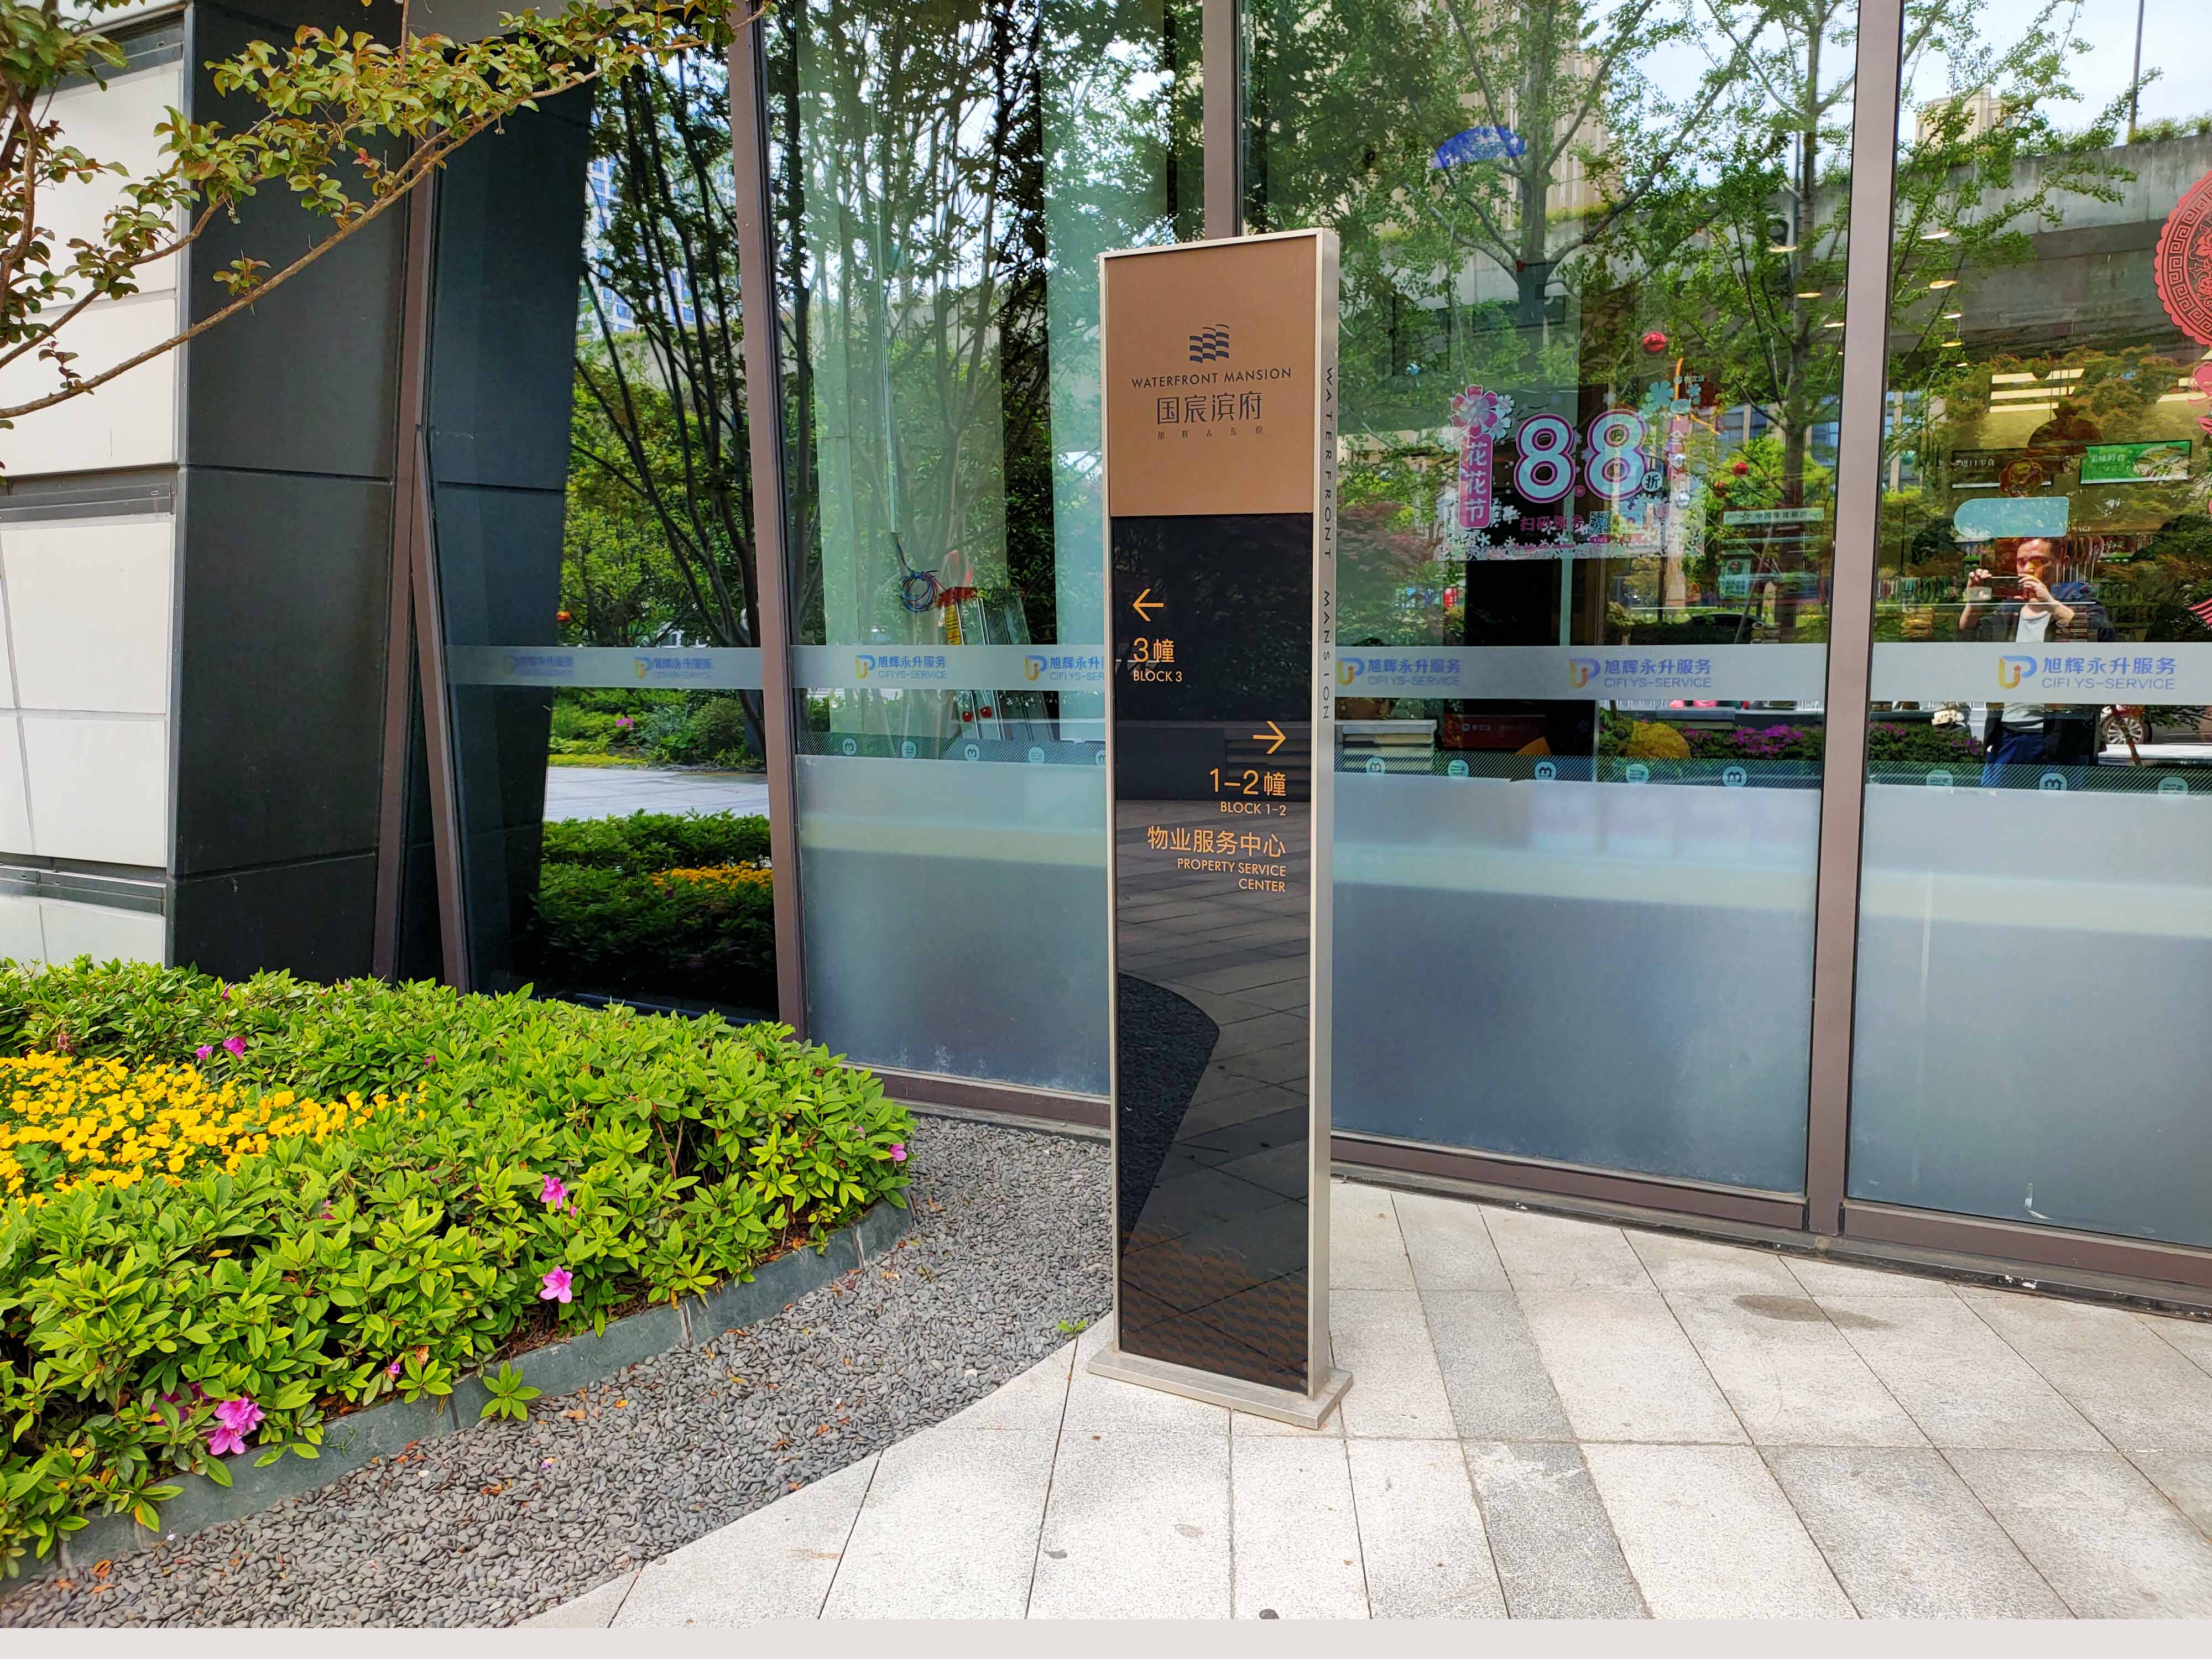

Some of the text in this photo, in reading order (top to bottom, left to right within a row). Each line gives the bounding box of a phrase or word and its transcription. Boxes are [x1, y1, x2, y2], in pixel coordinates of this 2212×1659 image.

[1131, 367, 1291, 388] WATERFRONT MANSION
[1157, 391, 1263, 425] 国宸滨府
[1464, 442, 1488, 523] 花花节
[1323, 367, 1333, 719] WATERFRONT MANSION
[878, 655, 946, 669] 旭辉永升服务
[1050, 656, 1104, 670] 旭辉永升
[1368, 659, 1460, 673] 旭辉永升服务
[1604, 659, 1712, 675] 旭辉永升服务
[2042, 656, 2177, 675] 旭辉永升服务
[1133, 670, 1182, 682] BLOCK 3
[1631, 677, 1712, 688] YS-SERVICE
[2042, 677, 2176, 690] CIFI YS-SERVICE
[1220, 801, 1286, 816] BLOCK 1-2
[1147, 825, 1286, 858] 物业服务中心
[1177, 858, 1286, 877] PROPERTY SERVICE
[1238, 878, 1286, 893] CENTER
